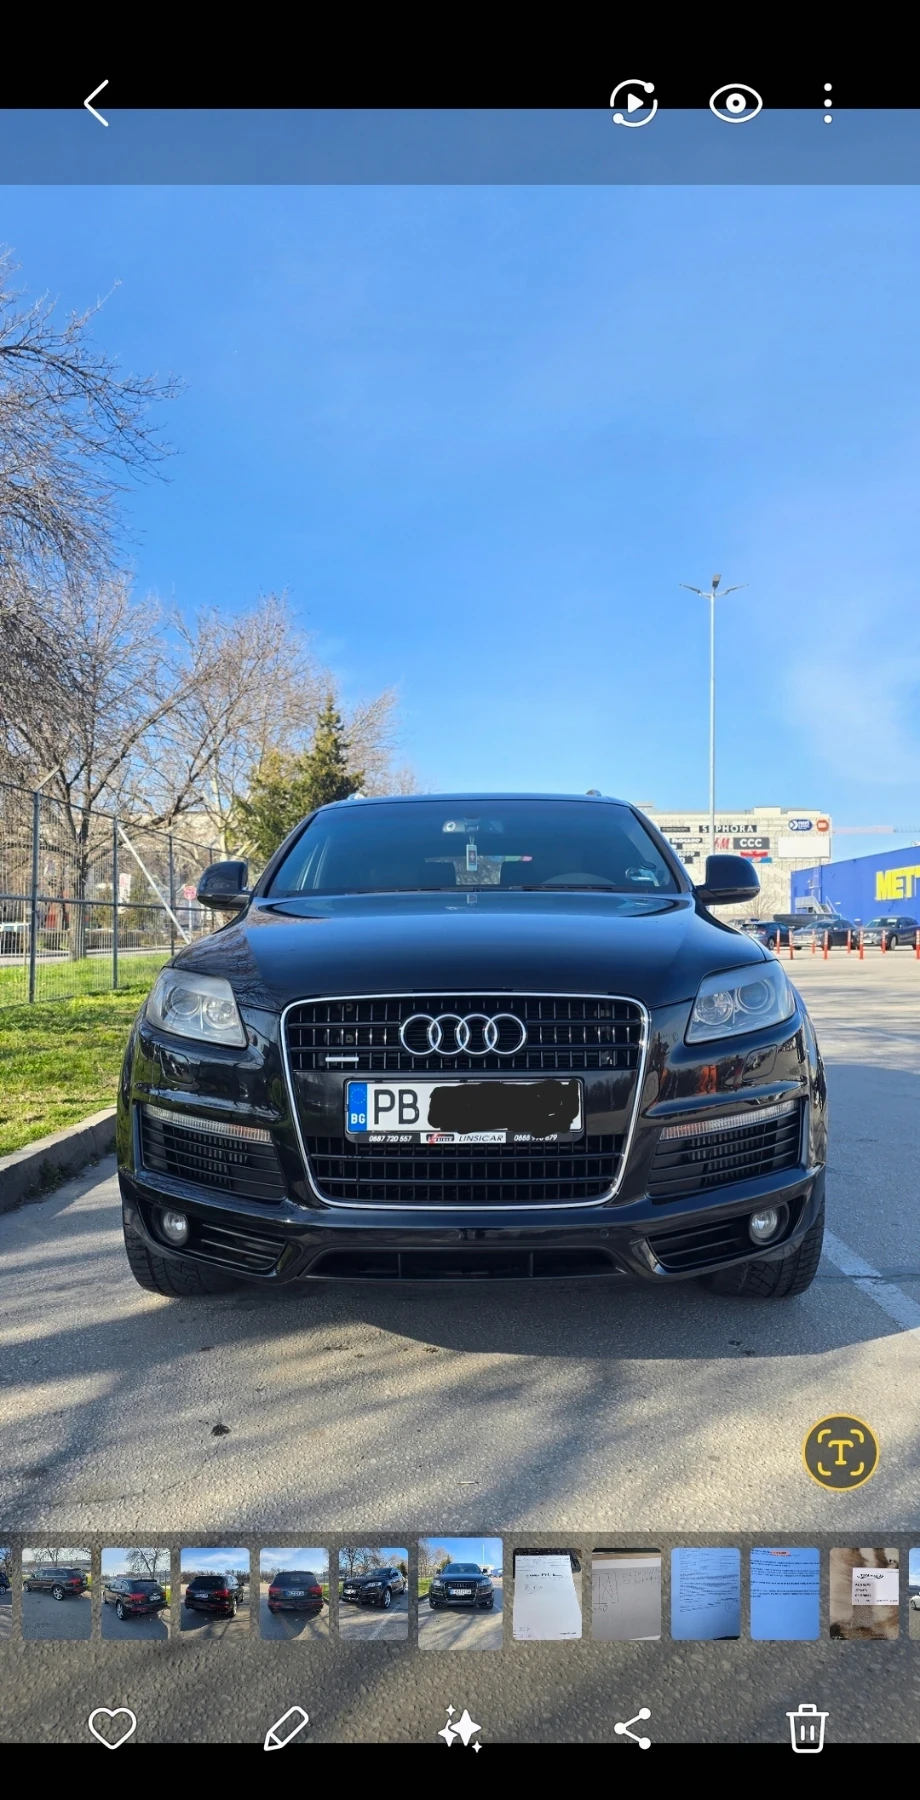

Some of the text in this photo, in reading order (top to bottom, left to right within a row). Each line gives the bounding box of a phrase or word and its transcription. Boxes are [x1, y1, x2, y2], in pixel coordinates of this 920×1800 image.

[702, 825, 754, 833] SPHORA
[739, 838, 763, 848] CCC
[373, 1088, 420, 1125] PB
[350, 1113, 366, 1125] BG
[458, 1134, 504, 1142] LINSICAR
